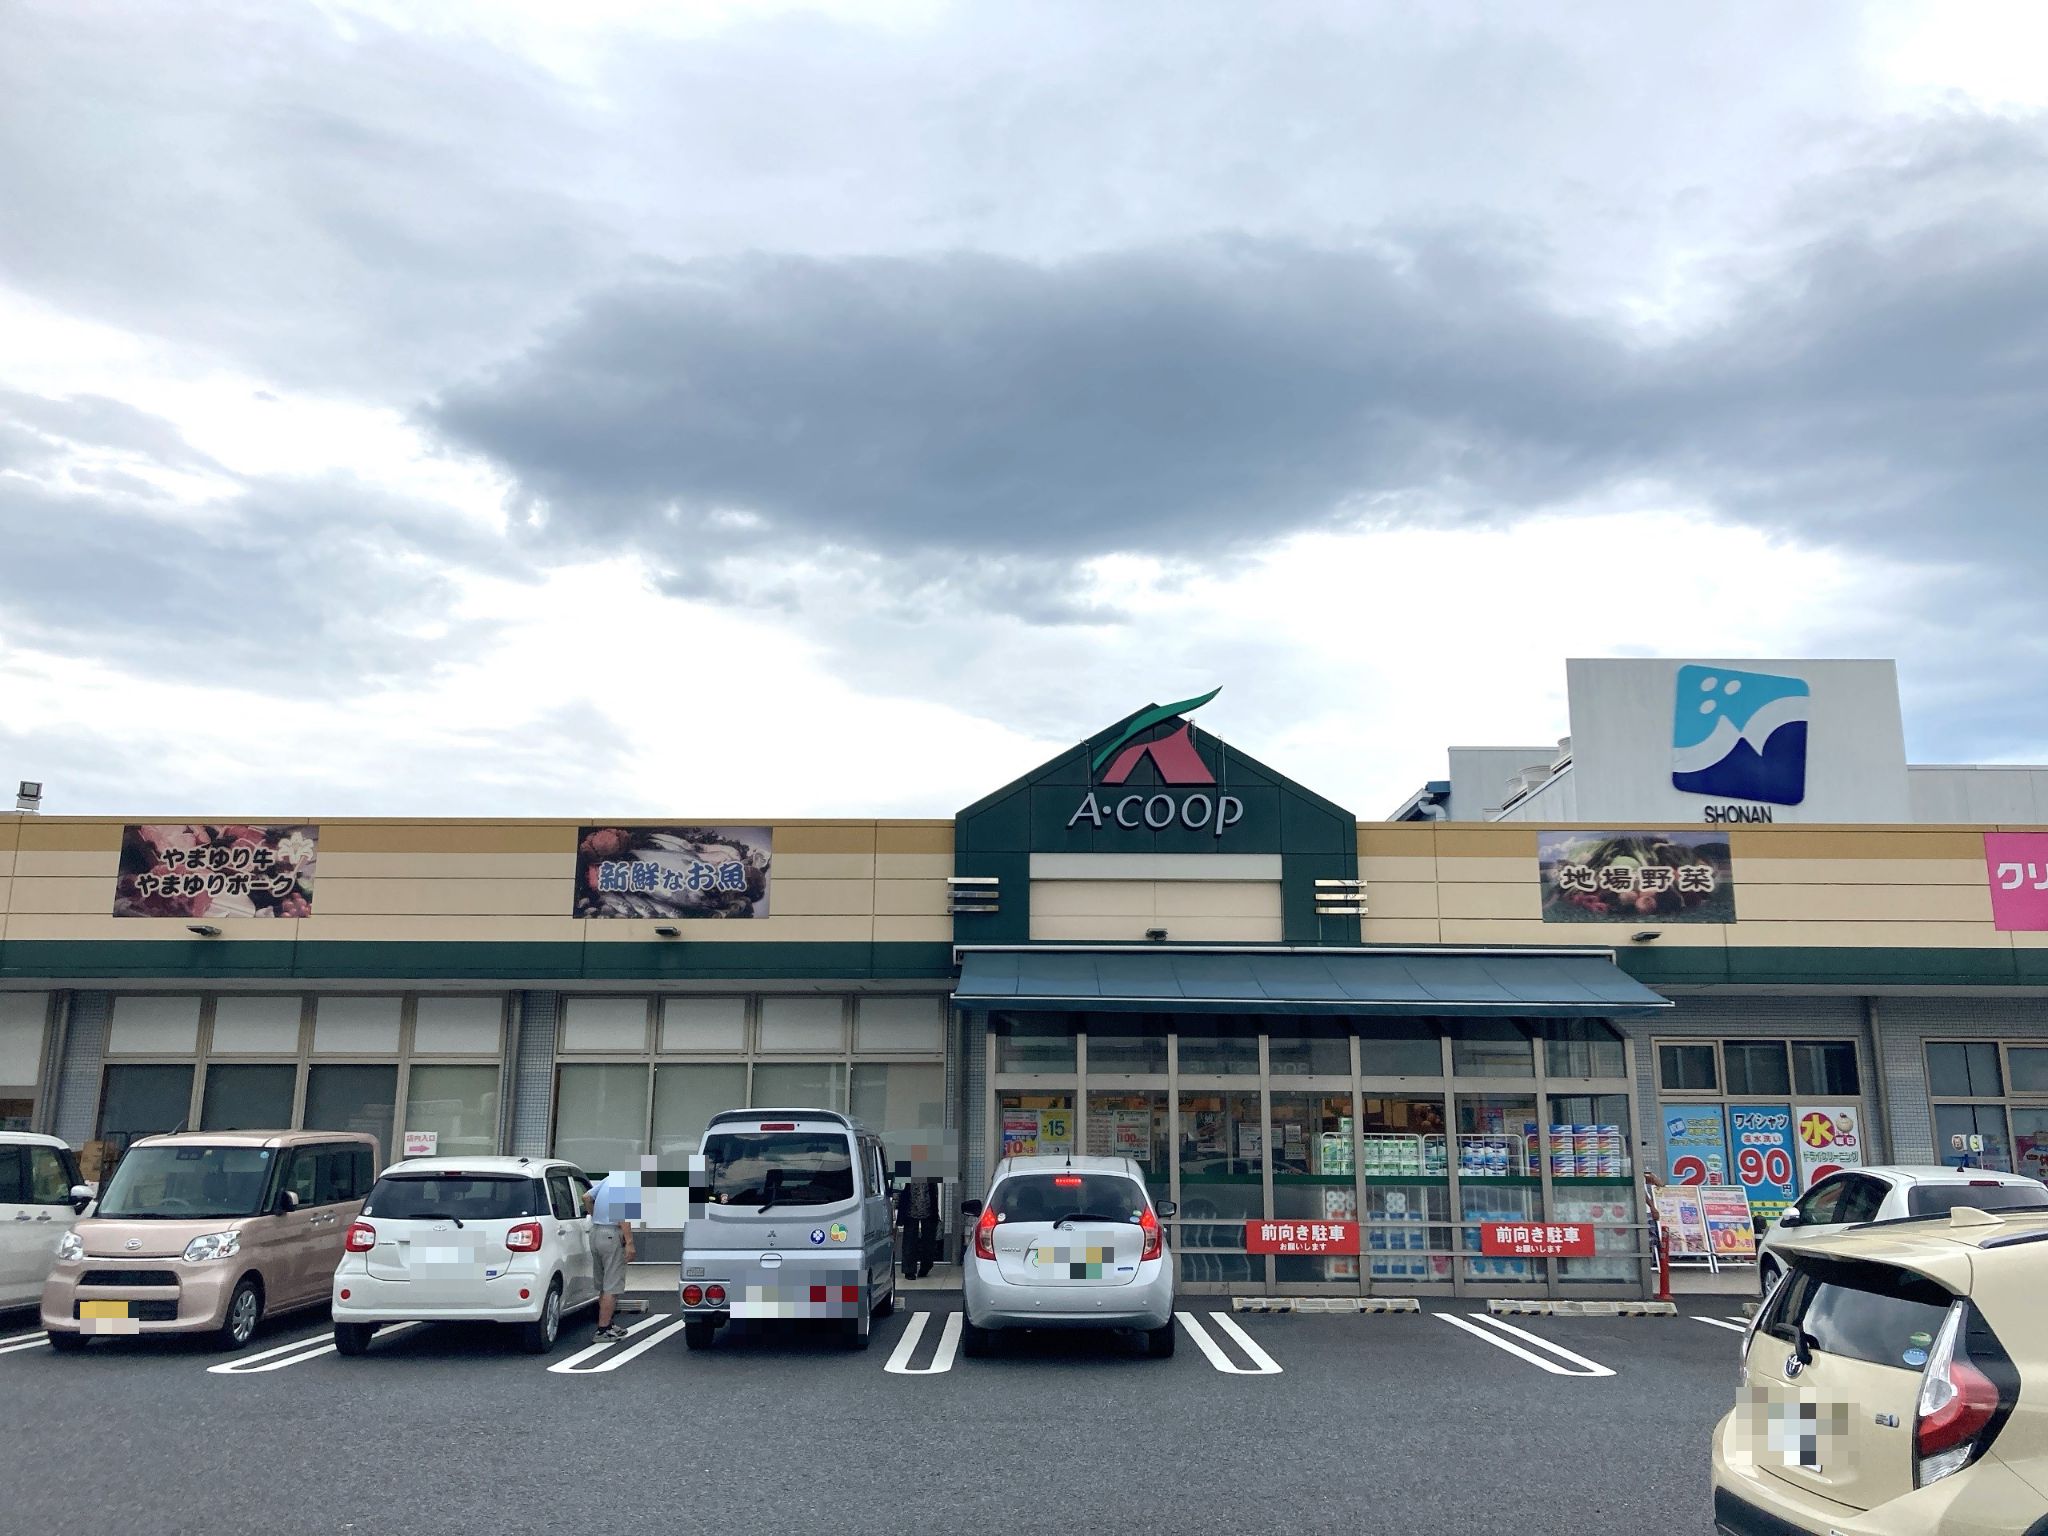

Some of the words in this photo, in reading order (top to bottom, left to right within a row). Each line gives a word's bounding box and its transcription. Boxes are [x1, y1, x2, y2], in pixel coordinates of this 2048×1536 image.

[1704, 805, 1773, 824] SHONAN
[162, 847, 274, 871] やまゆり牛
[598, 861, 748, 892] 新鮮なお魚
[1561, 866, 1715, 893] 地場野菜
[136, 874, 295, 898] やまゆりポーク
[1734, 1113, 1789, 1129] ワイシャツ
[1261, 1224, 1345, 1242] 前向き駐車
[1496, 1226, 1581, 1243] 前向き駐車
[1280, 1242, 1327, 1251] お願いします
[1515, 1244, 1562, 1253] お願いします
